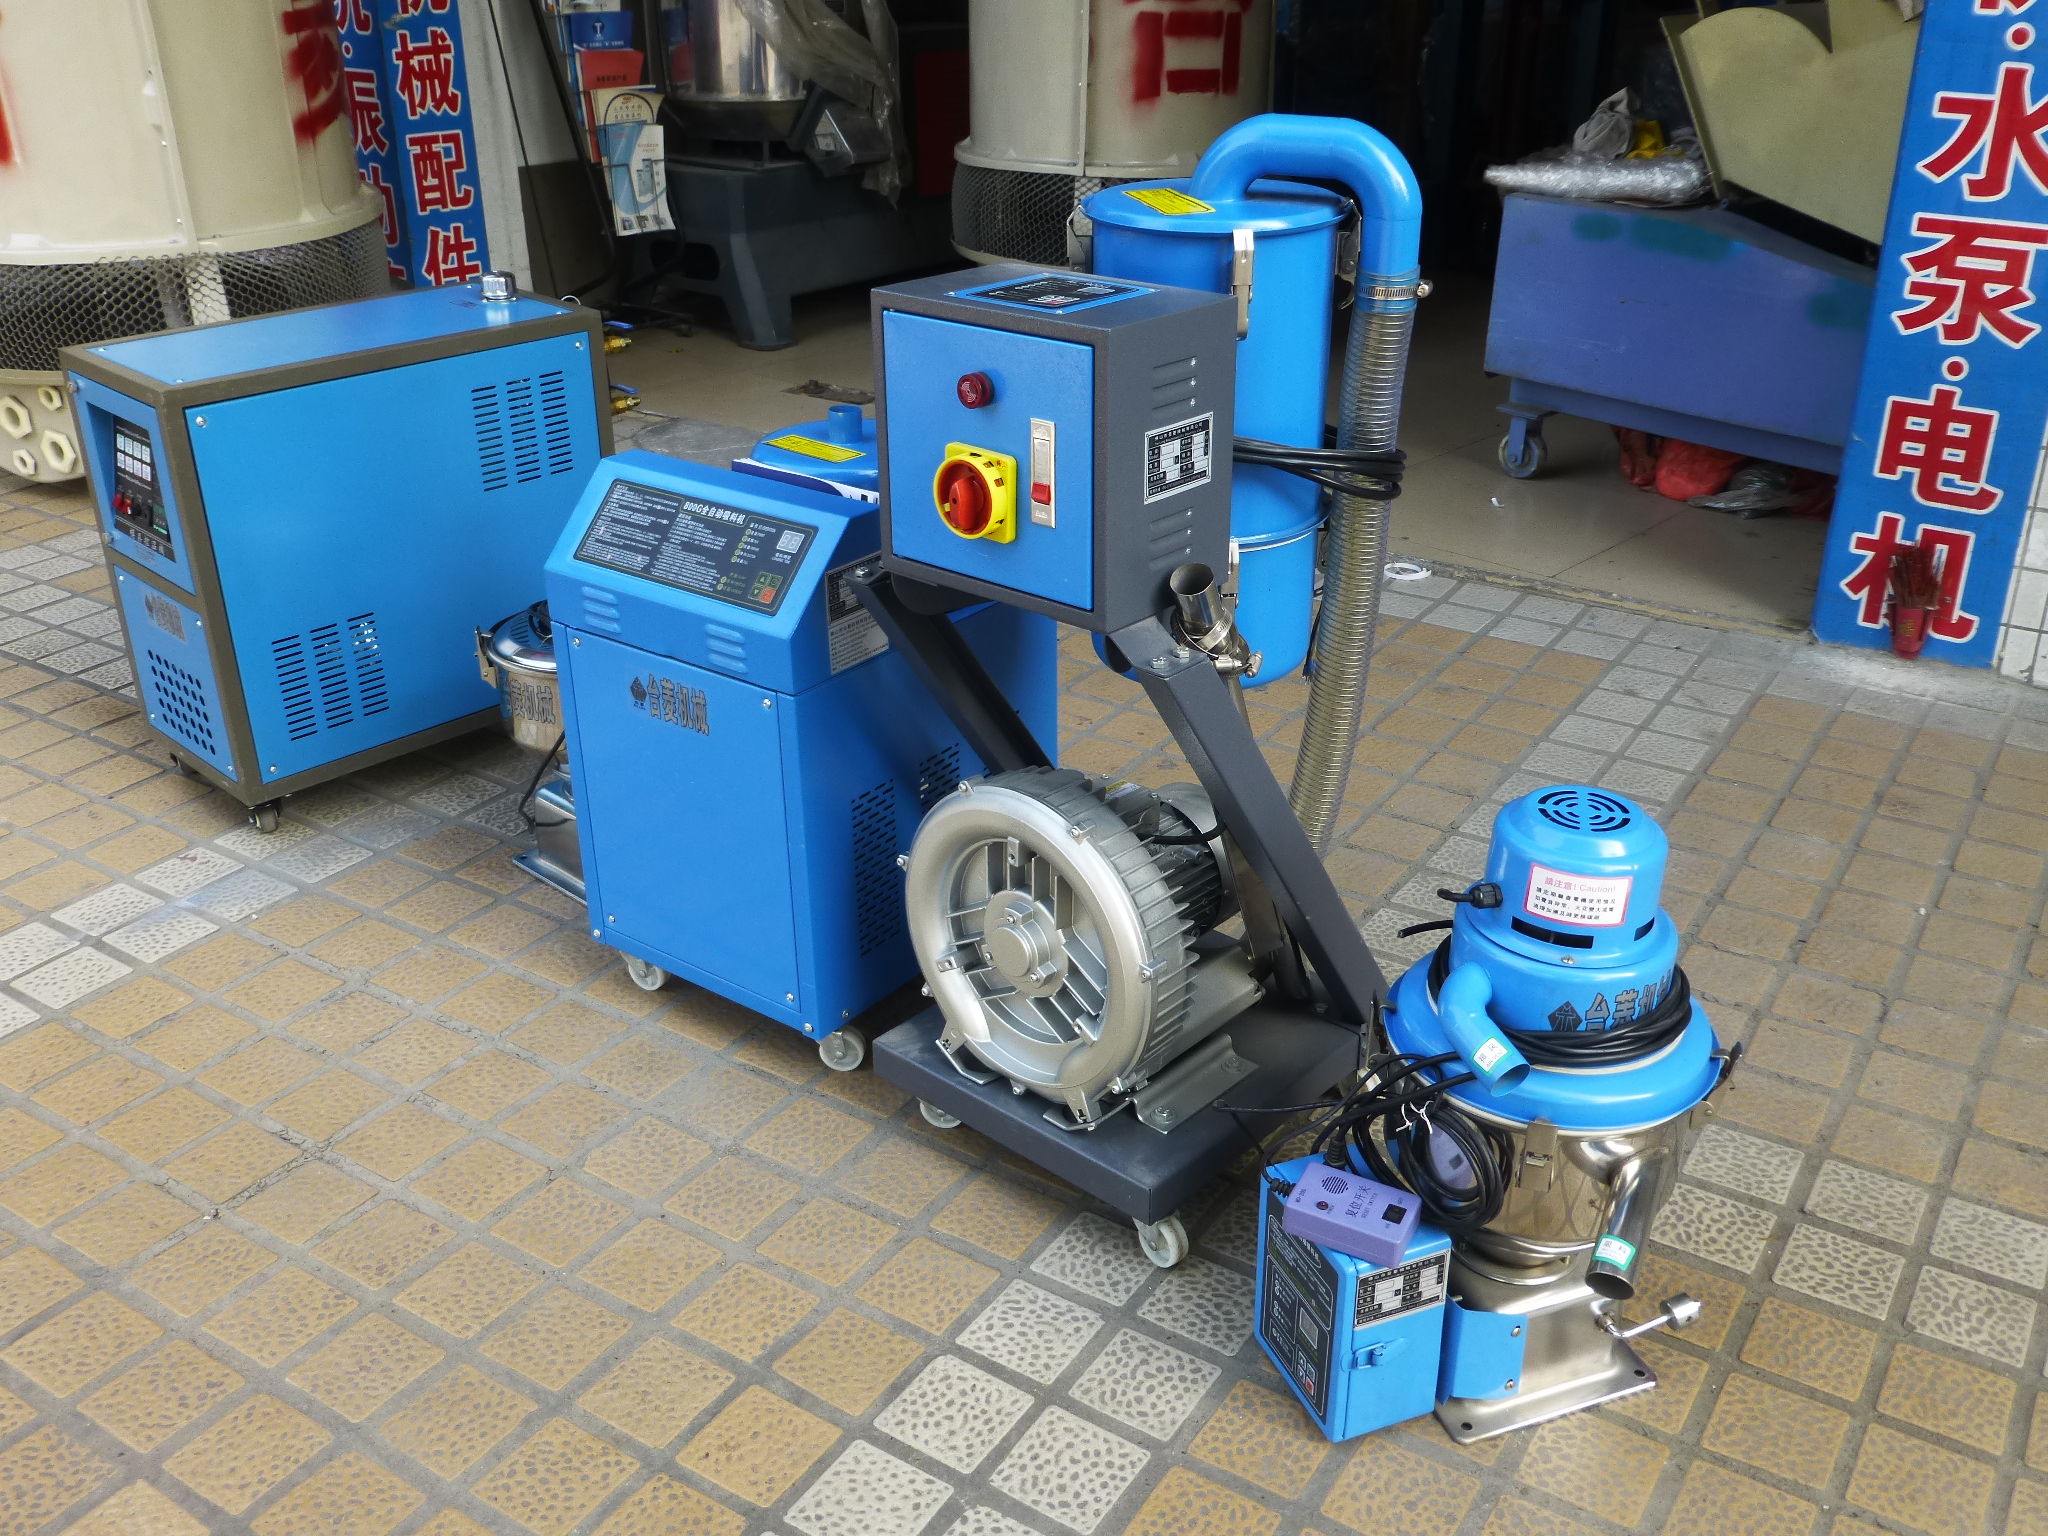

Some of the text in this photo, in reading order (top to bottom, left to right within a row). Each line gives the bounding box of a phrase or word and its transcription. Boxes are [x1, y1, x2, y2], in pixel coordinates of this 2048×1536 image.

[393, 0, 482, 286] 械配件
[1842, 0, 2048, 644] ·水泵·电机
[647, 673, 710, 736] 台菱机械
[1579, 884, 1617, 893] Caution!
[1345, 1185, 1371, 1218] 复位开关
